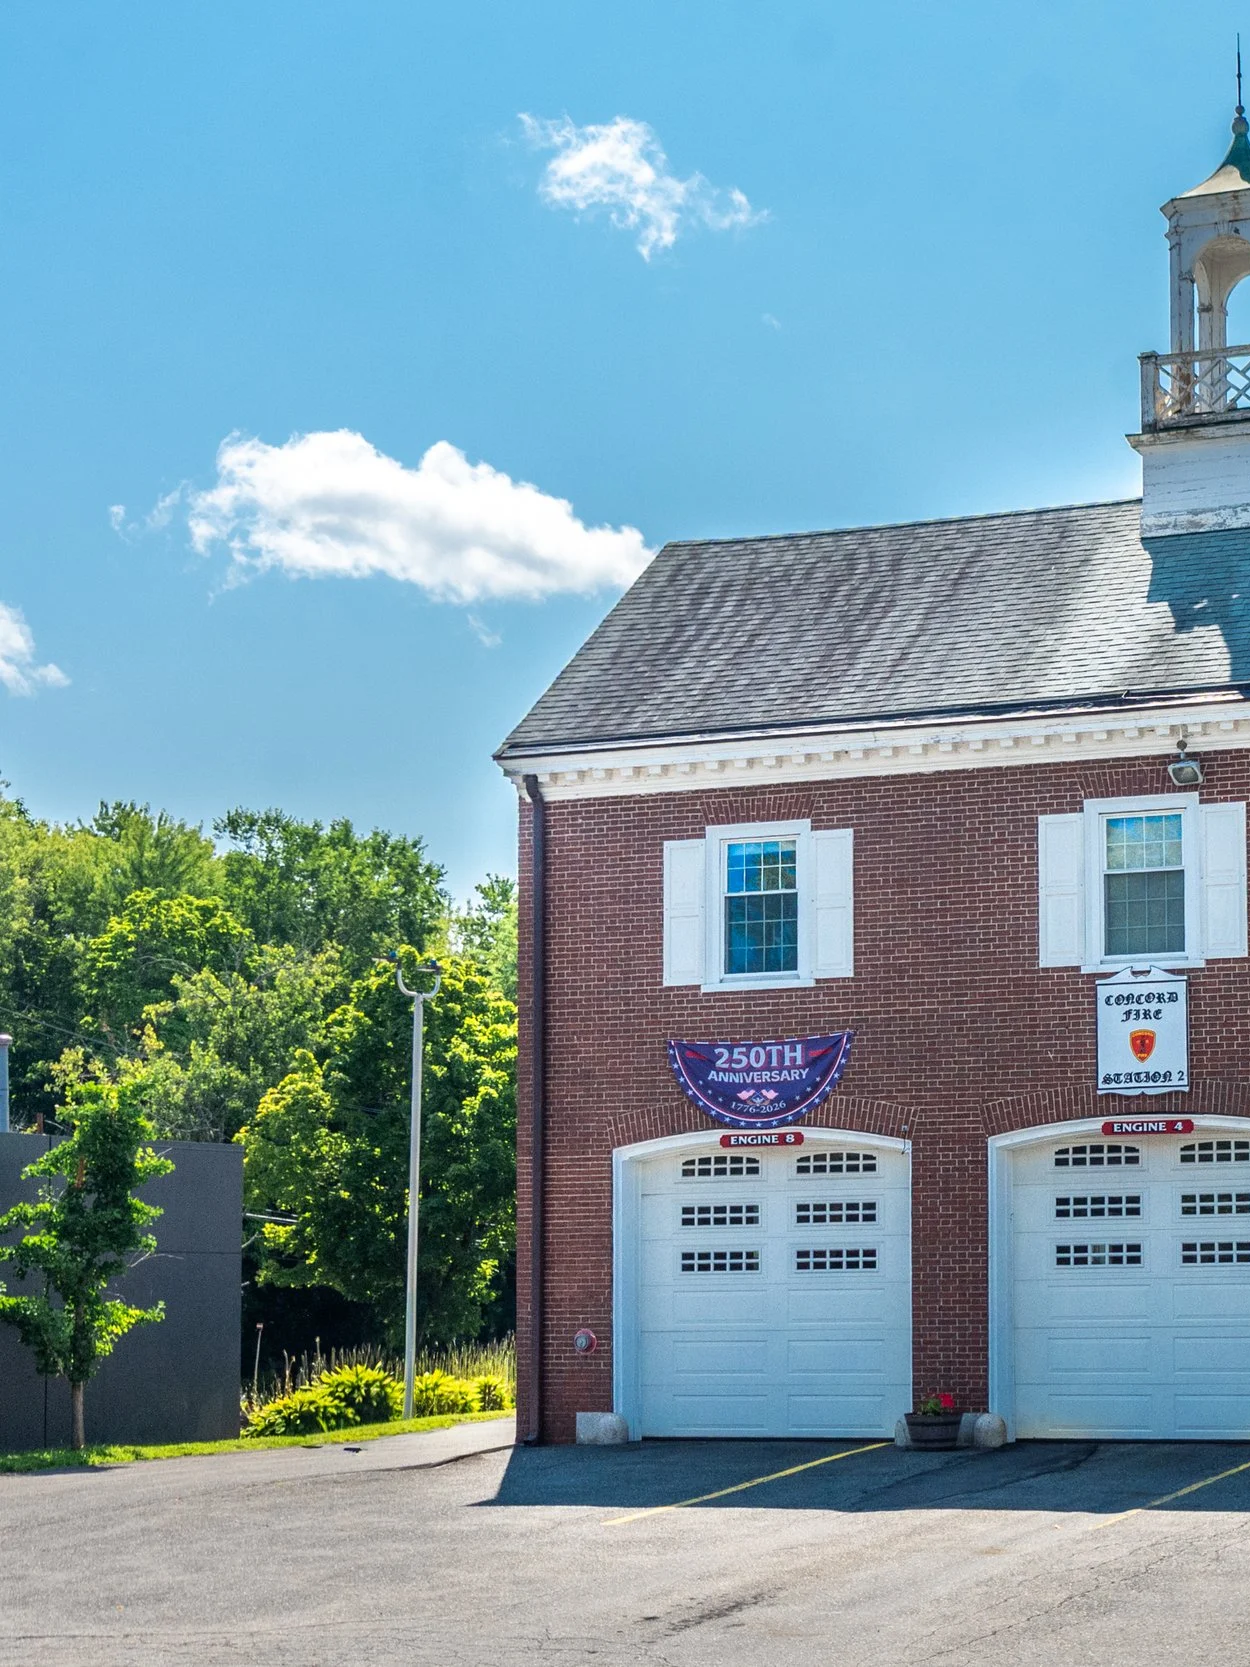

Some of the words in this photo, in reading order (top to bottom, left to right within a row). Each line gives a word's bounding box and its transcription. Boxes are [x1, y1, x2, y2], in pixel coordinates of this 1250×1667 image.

[1104, 991, 1179, 1005] CONCORD
[1121, 1008, 1163, 1022] FIRE
[713, 1044, 803, 1069] 250TH
[707, 1068, 810, 1083] ANNIVERSARY
[1101, 1070, 1172, 1085] STATION
[1177, 1070, 1185, 1081] 2
[730, 1101, 787, 1114] 1776-2026
[1113, 1122, 1167, 1132] ENGINE
[1174, 1121, 1183, 1131] 4
[730, 1134, 779, 1145] ENGINE
[785, 1134, 795, 1143] 8
